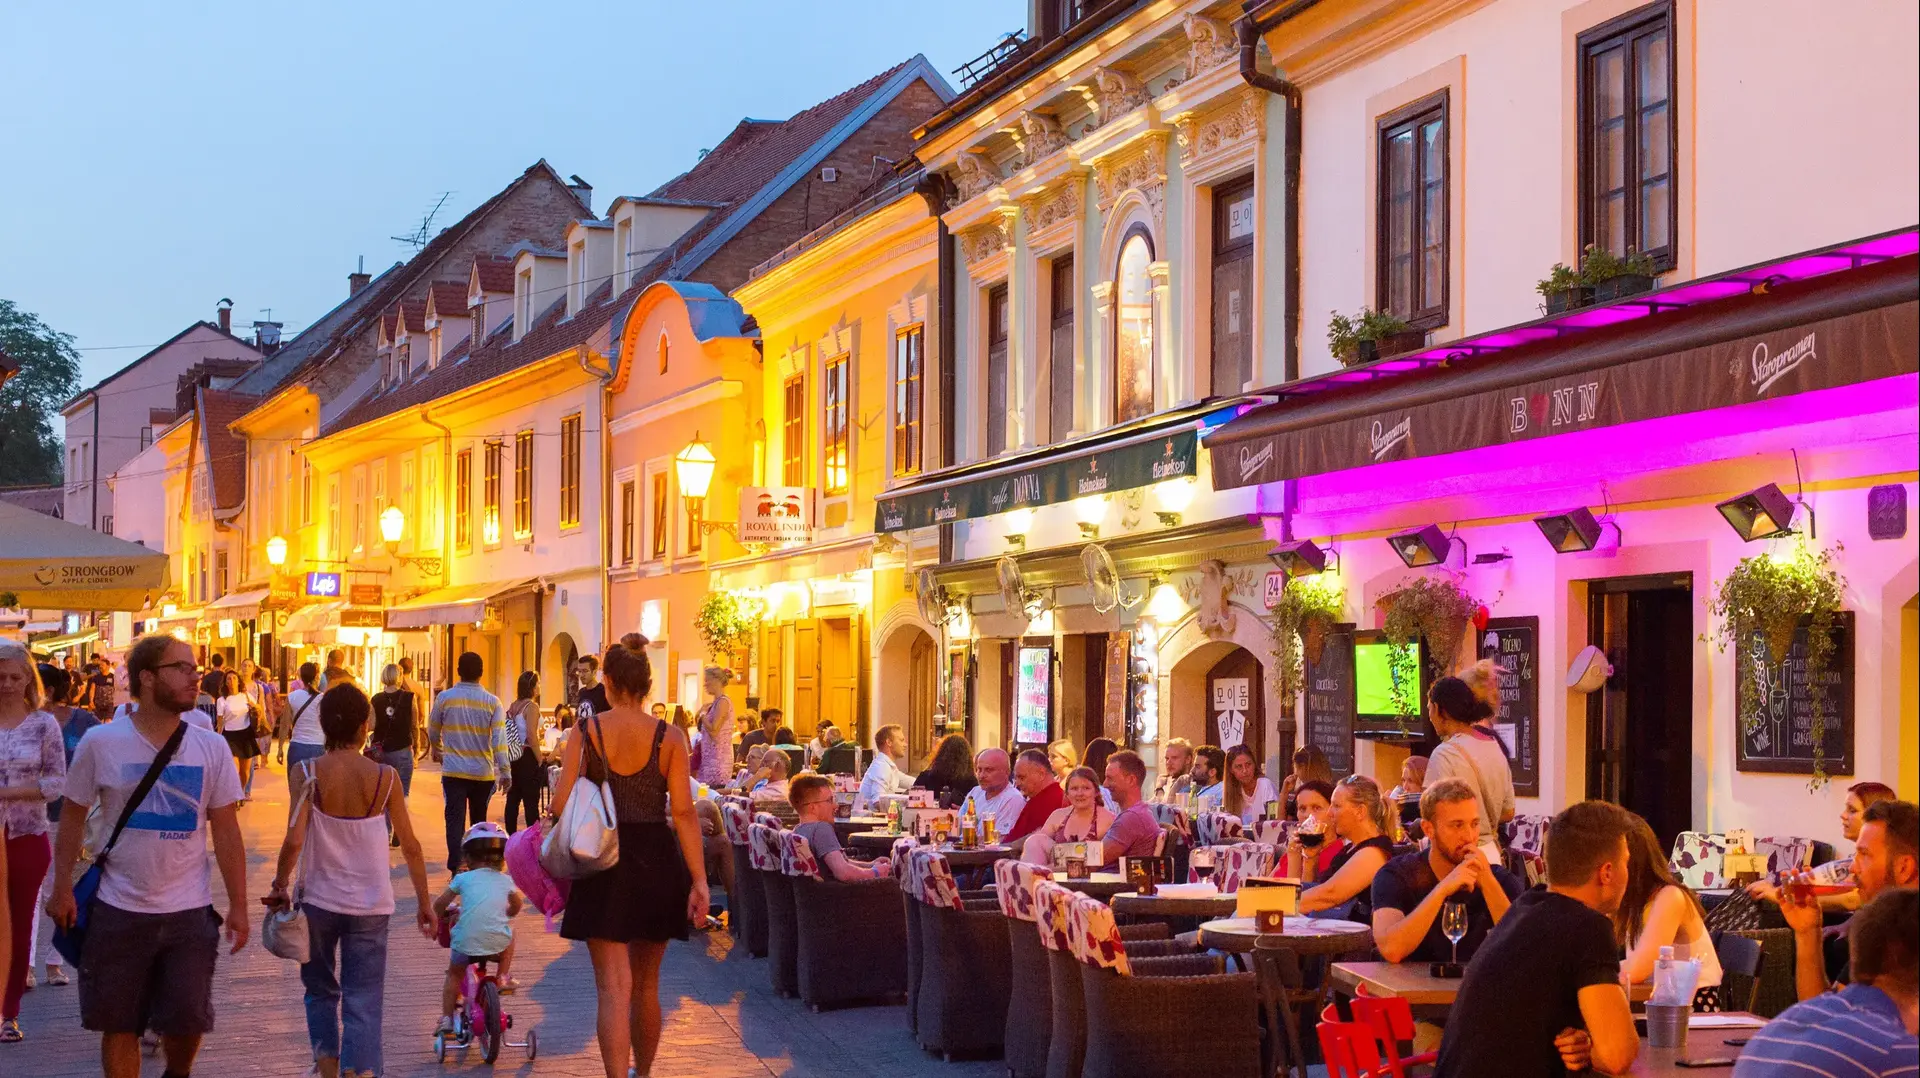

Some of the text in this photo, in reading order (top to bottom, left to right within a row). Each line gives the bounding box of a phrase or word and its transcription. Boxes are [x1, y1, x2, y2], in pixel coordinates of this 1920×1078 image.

[1751, 333, 1817, 394] Staropramen
[1152, 459, 1186, 479] Heineken
[1013, 474, 1041, 504] DONNA
[1078, 476, 1107, 494] Heineken
[934, 505, 957, 521] Heineken
[746, 522, 813, 532] ROYAL INDIA
[61, 565, 136, 577] STRONGBOW
[1268, 576, 1279, 596] 24
